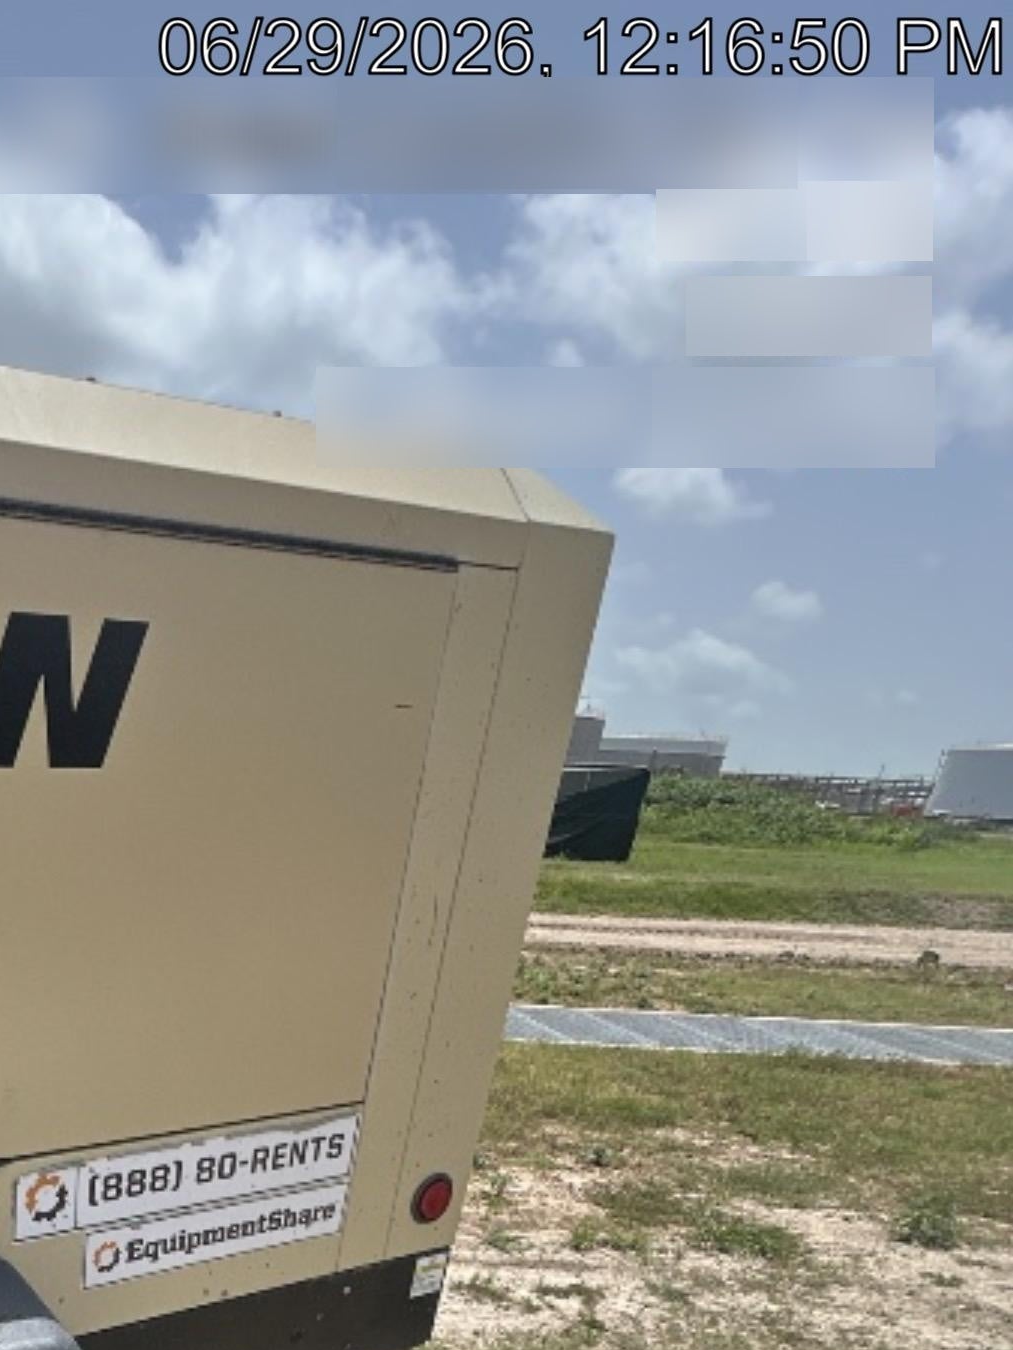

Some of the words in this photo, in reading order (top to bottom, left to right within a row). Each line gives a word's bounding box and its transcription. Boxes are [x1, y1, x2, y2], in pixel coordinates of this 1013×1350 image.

[88, 1159, 184, 1206] (888)
[196, 1132, 347, 1185] 80-RENTS
[124, 1202, 337, 1263] EquipmentShare
